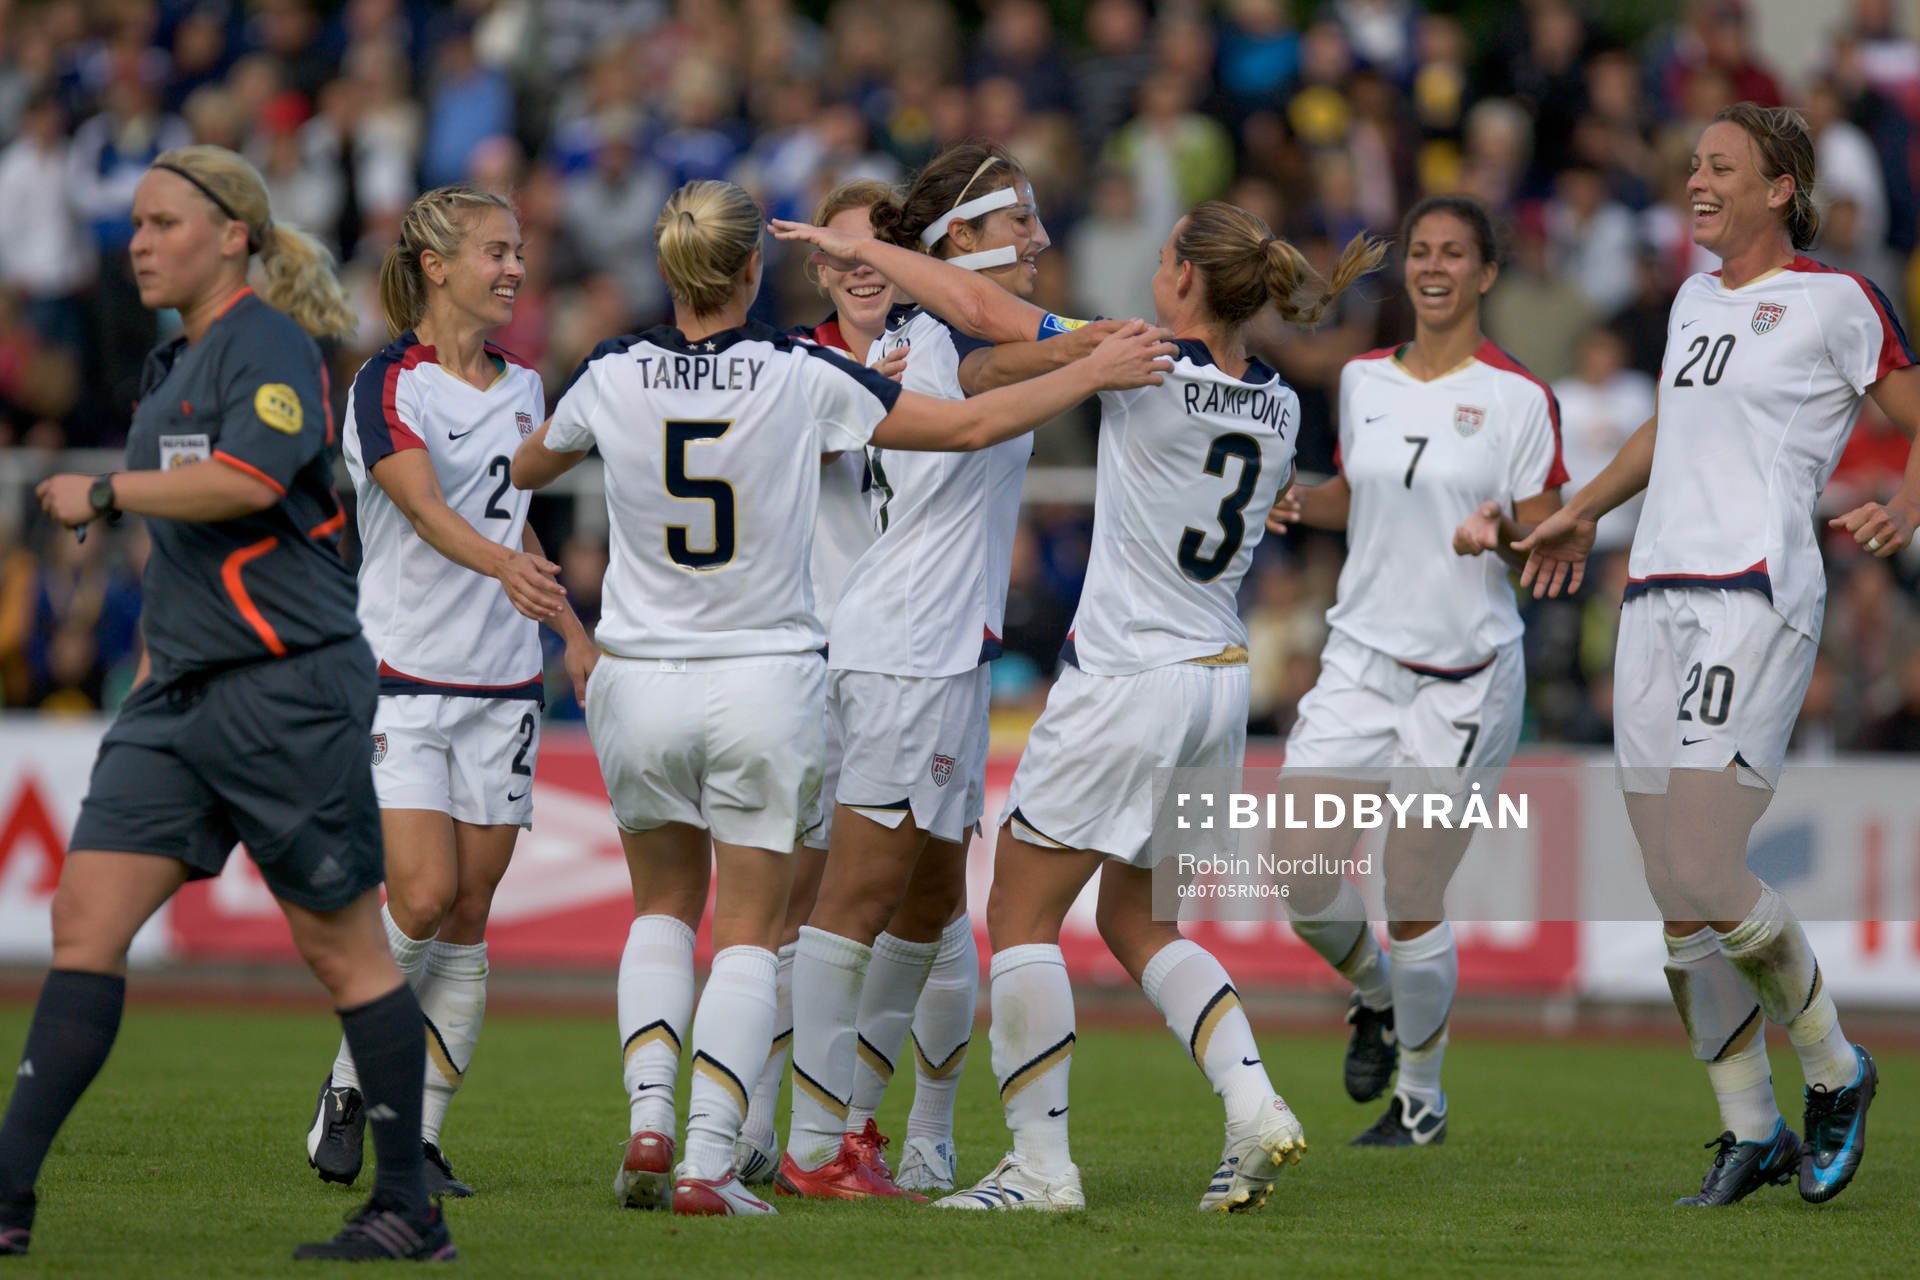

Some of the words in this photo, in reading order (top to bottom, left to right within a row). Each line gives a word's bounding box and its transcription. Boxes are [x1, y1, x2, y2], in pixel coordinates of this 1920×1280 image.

[637, 356, 765, 391] TARPLEY
[1674, 334, 1736, 388] 20
[1184, 382, 1291, 441] RAMPONE
[484, 454, 511, 519] 2
[1403, 435, 1429, 490] 7
[663, 418, 738, 574] 5
[1177, 432, 1262, 584] 3
[1676, 661, 1735, 726] 20
[511, 712, 535, 777] 2
[1452, 720, 1480, 775] 7
